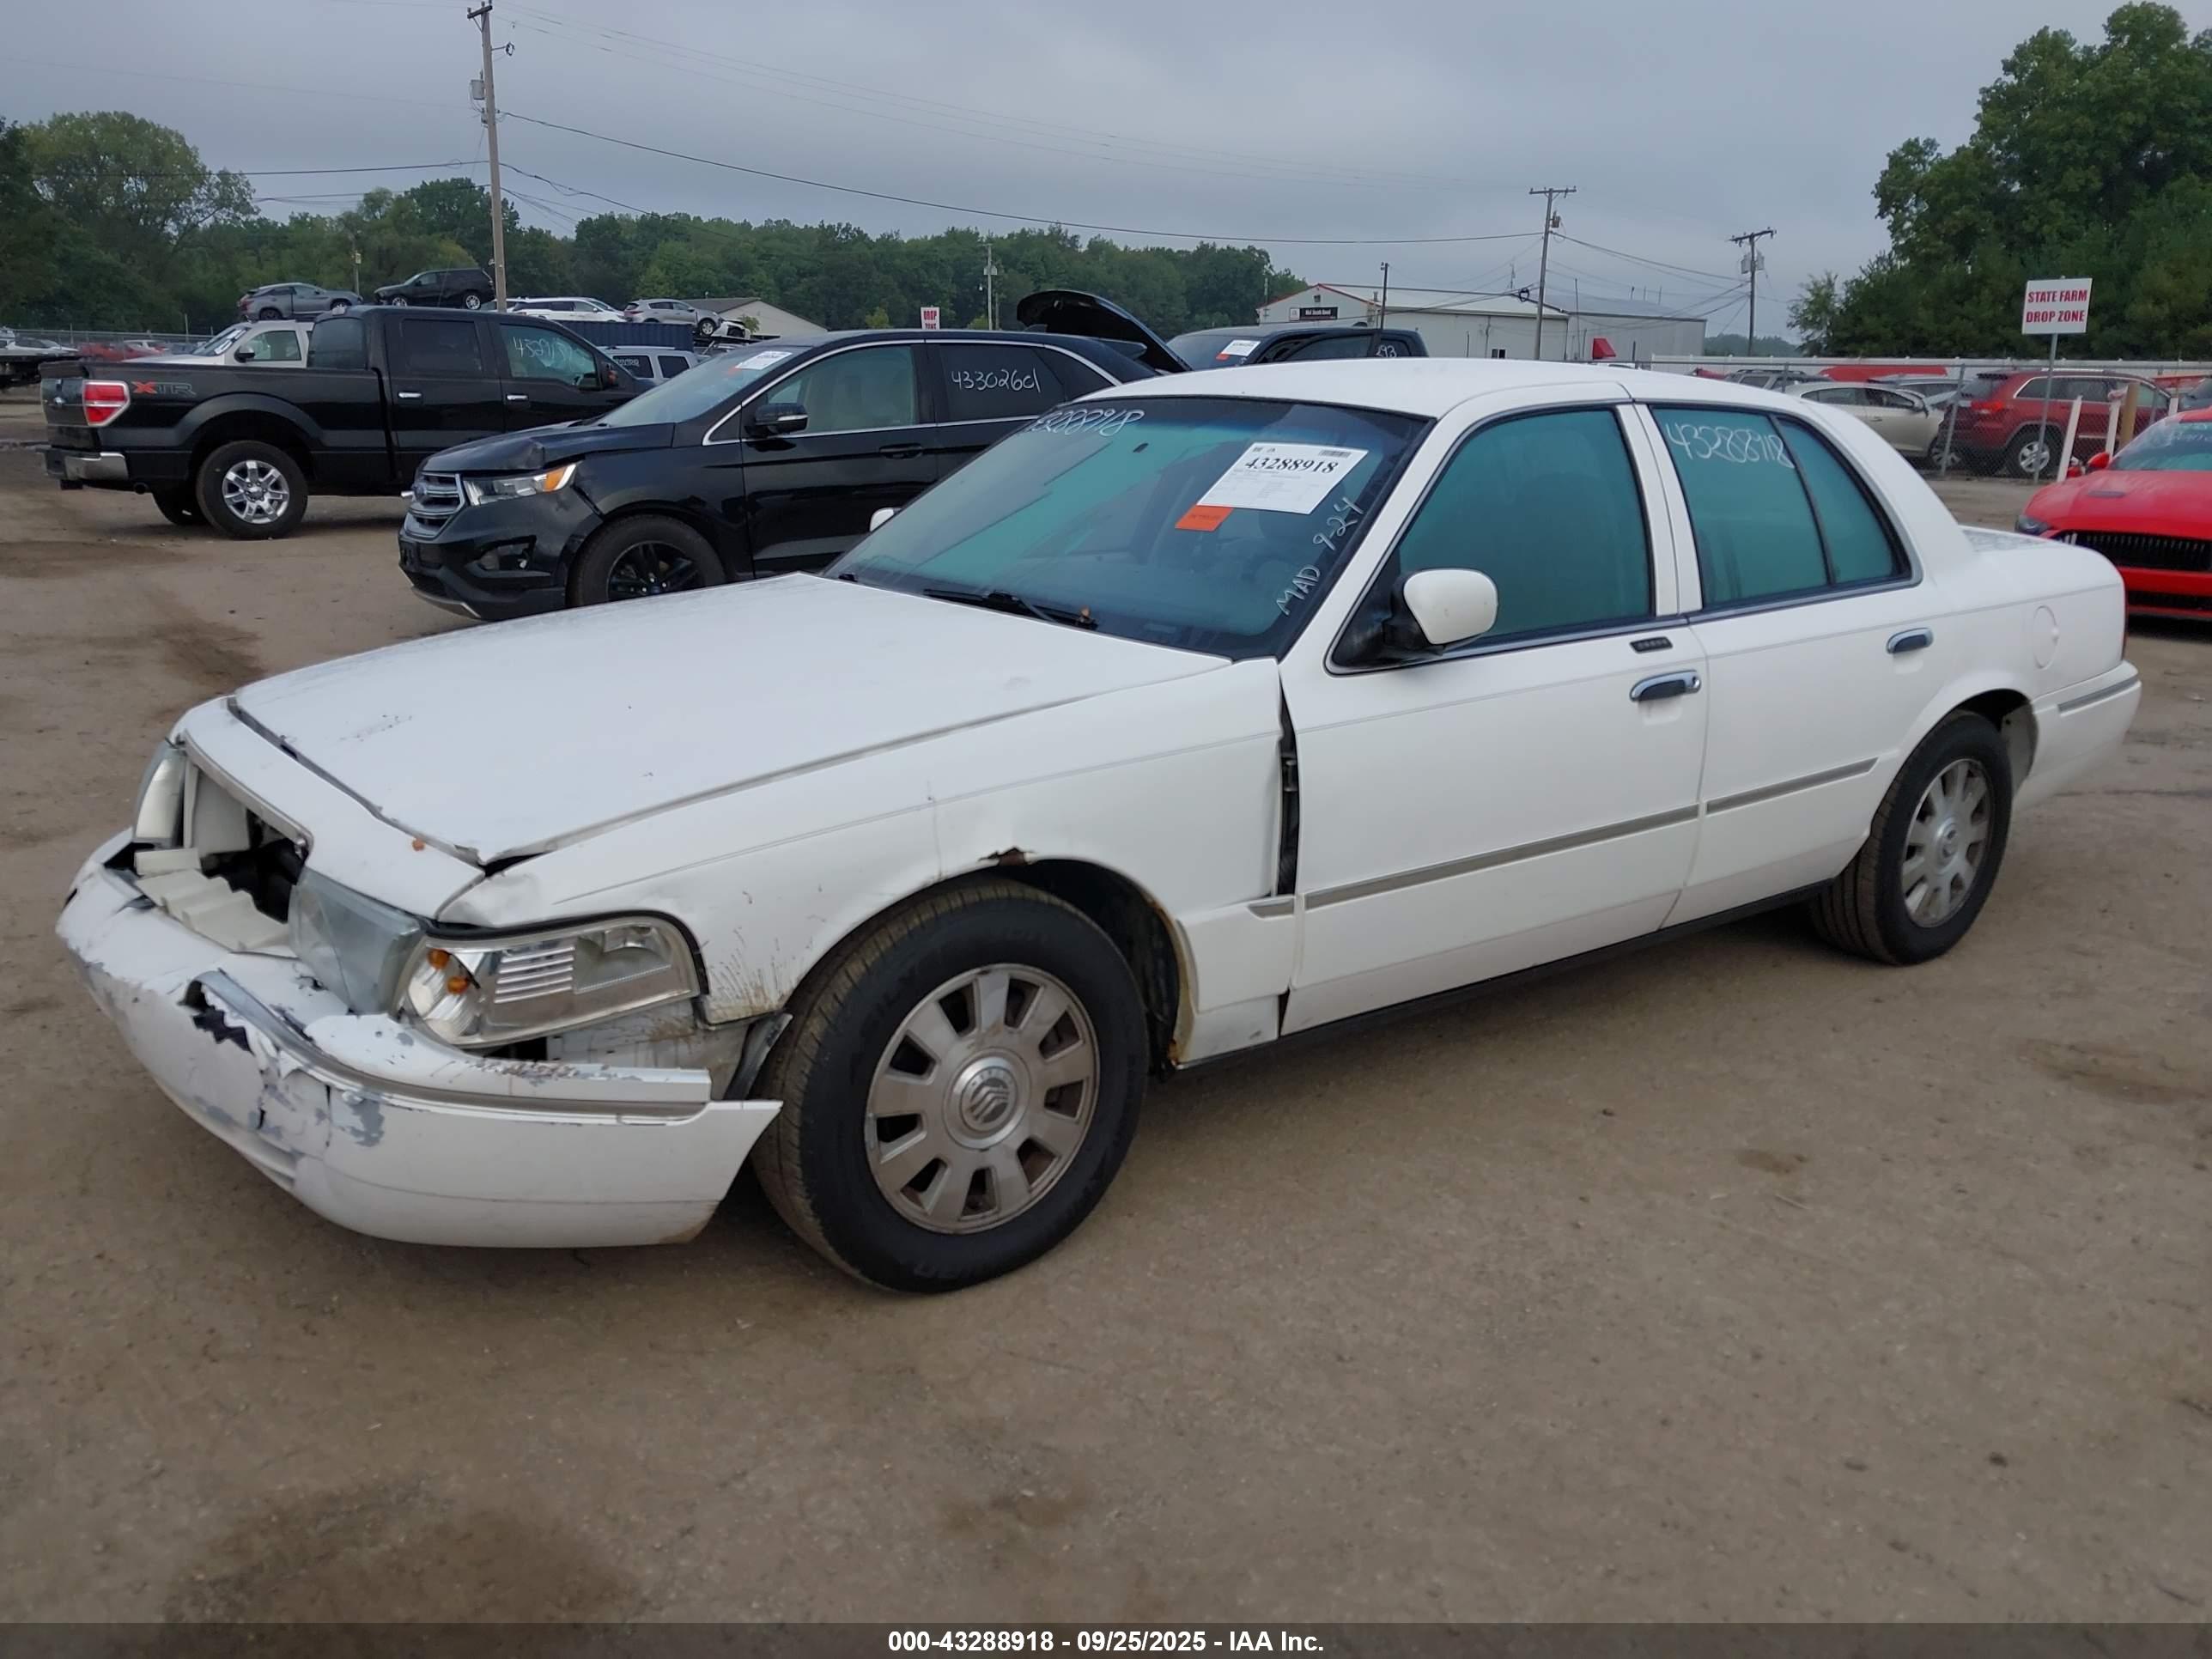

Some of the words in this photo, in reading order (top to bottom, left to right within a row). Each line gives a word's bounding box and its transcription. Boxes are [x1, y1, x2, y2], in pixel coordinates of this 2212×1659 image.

[2027, 290, 2057, 303] STATE
[2059, 289, 2088, 302] FARM
[2026, 311, 2056, 323] DROP
[2057, 309, 2085, 322] ZONE
[1244, 456, 1339, 474] 43288918
